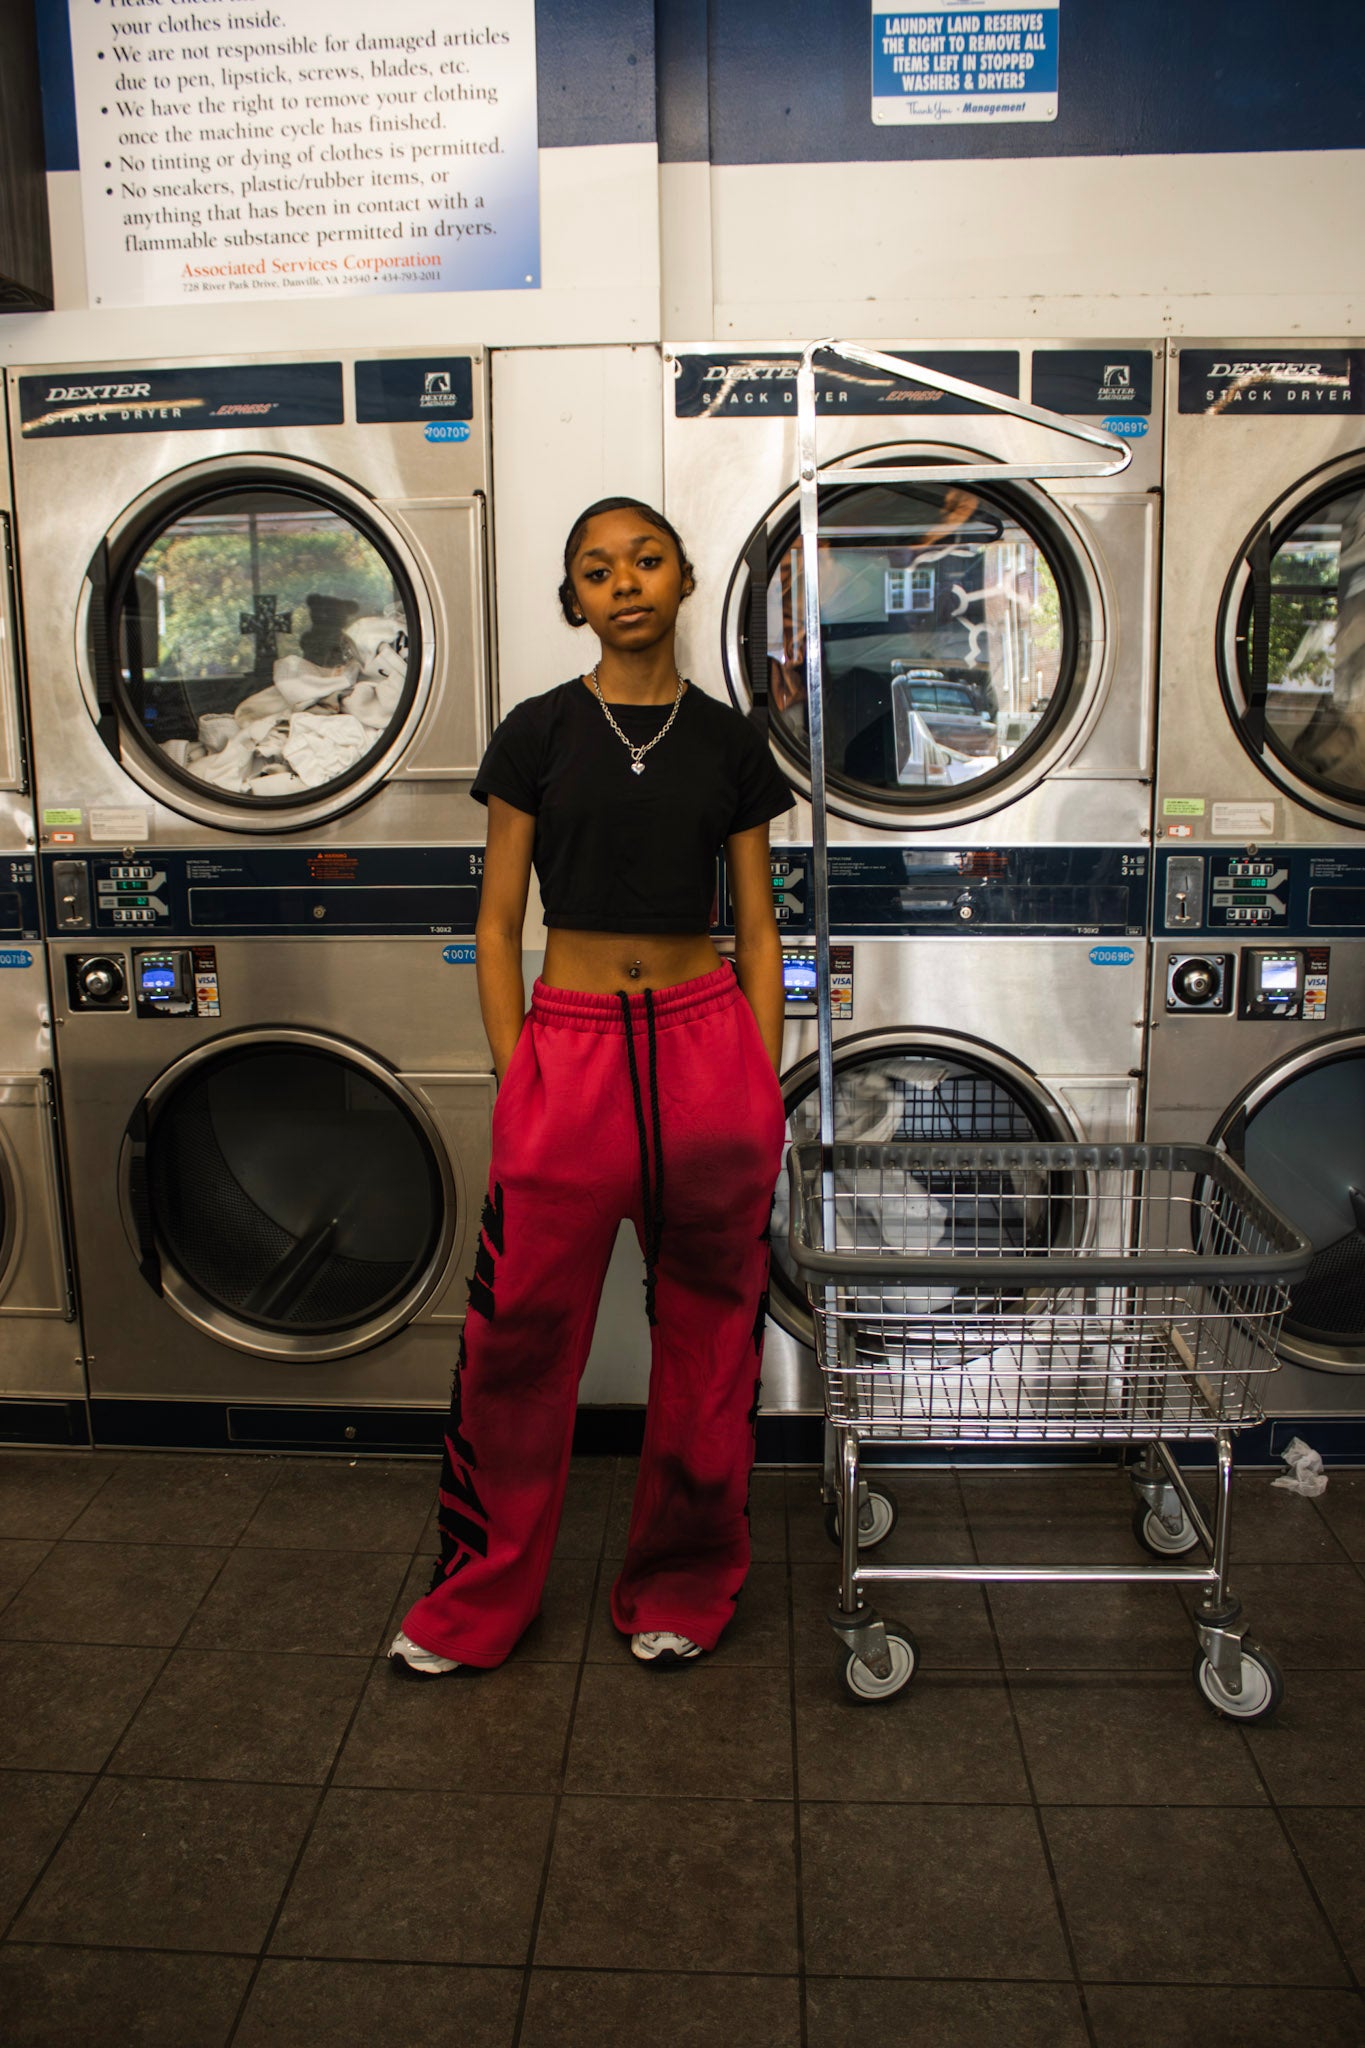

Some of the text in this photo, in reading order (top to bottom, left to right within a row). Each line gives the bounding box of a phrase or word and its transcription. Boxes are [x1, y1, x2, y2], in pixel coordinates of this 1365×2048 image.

[111, 10, 286, 41] your clothes inside.
[885, 13, 1043, 35] LAUNDRY LAND RESERVES
[112, 27, 510, 63] We are not responsible for damaged articles
[882, 33, 1046, 54] THE RIGHT TO REMOVE ALL
[893, 52, 1034, 73] ITEMS LEFT IN STOPPED
[115, 59, 470, 93] due to pen, lipstick, screws, blades, etc.
[902, 72, 1025, 92] WASHERS & DRYERS
[115, 83, 499, 118] We have the right to remove your clothing
[905, 101, 934, 115] Thank
[962, 101, 1026, 113] Management
[118, 112, 447, 145] once the machine cycle has finished.
[119, 136, 505, 172] No tinting or dying of clothes is permitted.
[120, 170, 450, 199] No sneakers, plastic/rubber items, or
[123, 192, 485, 229] anything that has been in contact with a
[125, 219, 497, 252] flammable substance permitted in dryers.
[181, 252, 441, 278] Associated Services Corporation
[183, 282, 200, 292] 728
[202, 280, 226, 292] River
[229, 279, 250, 291] Park
[252, 278, 280, 290] Drive,
[282, 275, 324, 289] Danville,
[326, 276, 339, 285] VA
[702, 365, 798, 380] DEXTE
[1207, 363, 1322, 377] DEXTER
[45, 383, 151, 402] DEXTER
[784, 391, 848, 402] DYER
[1206, 390, 1351, 401] STACK DRYER
[121, 407, 182, 420] DRYER
[427, 427, 465, 438] 70070T
[469, 854, 476, 864] 3
[1122, 855, 1129, 864] 3
[469, 866, 476, 875] 3
[1121, 867, 1128, 876] 3
[198, 976, 216, 984] VISA
[832, 977, 851, 985] VISA
